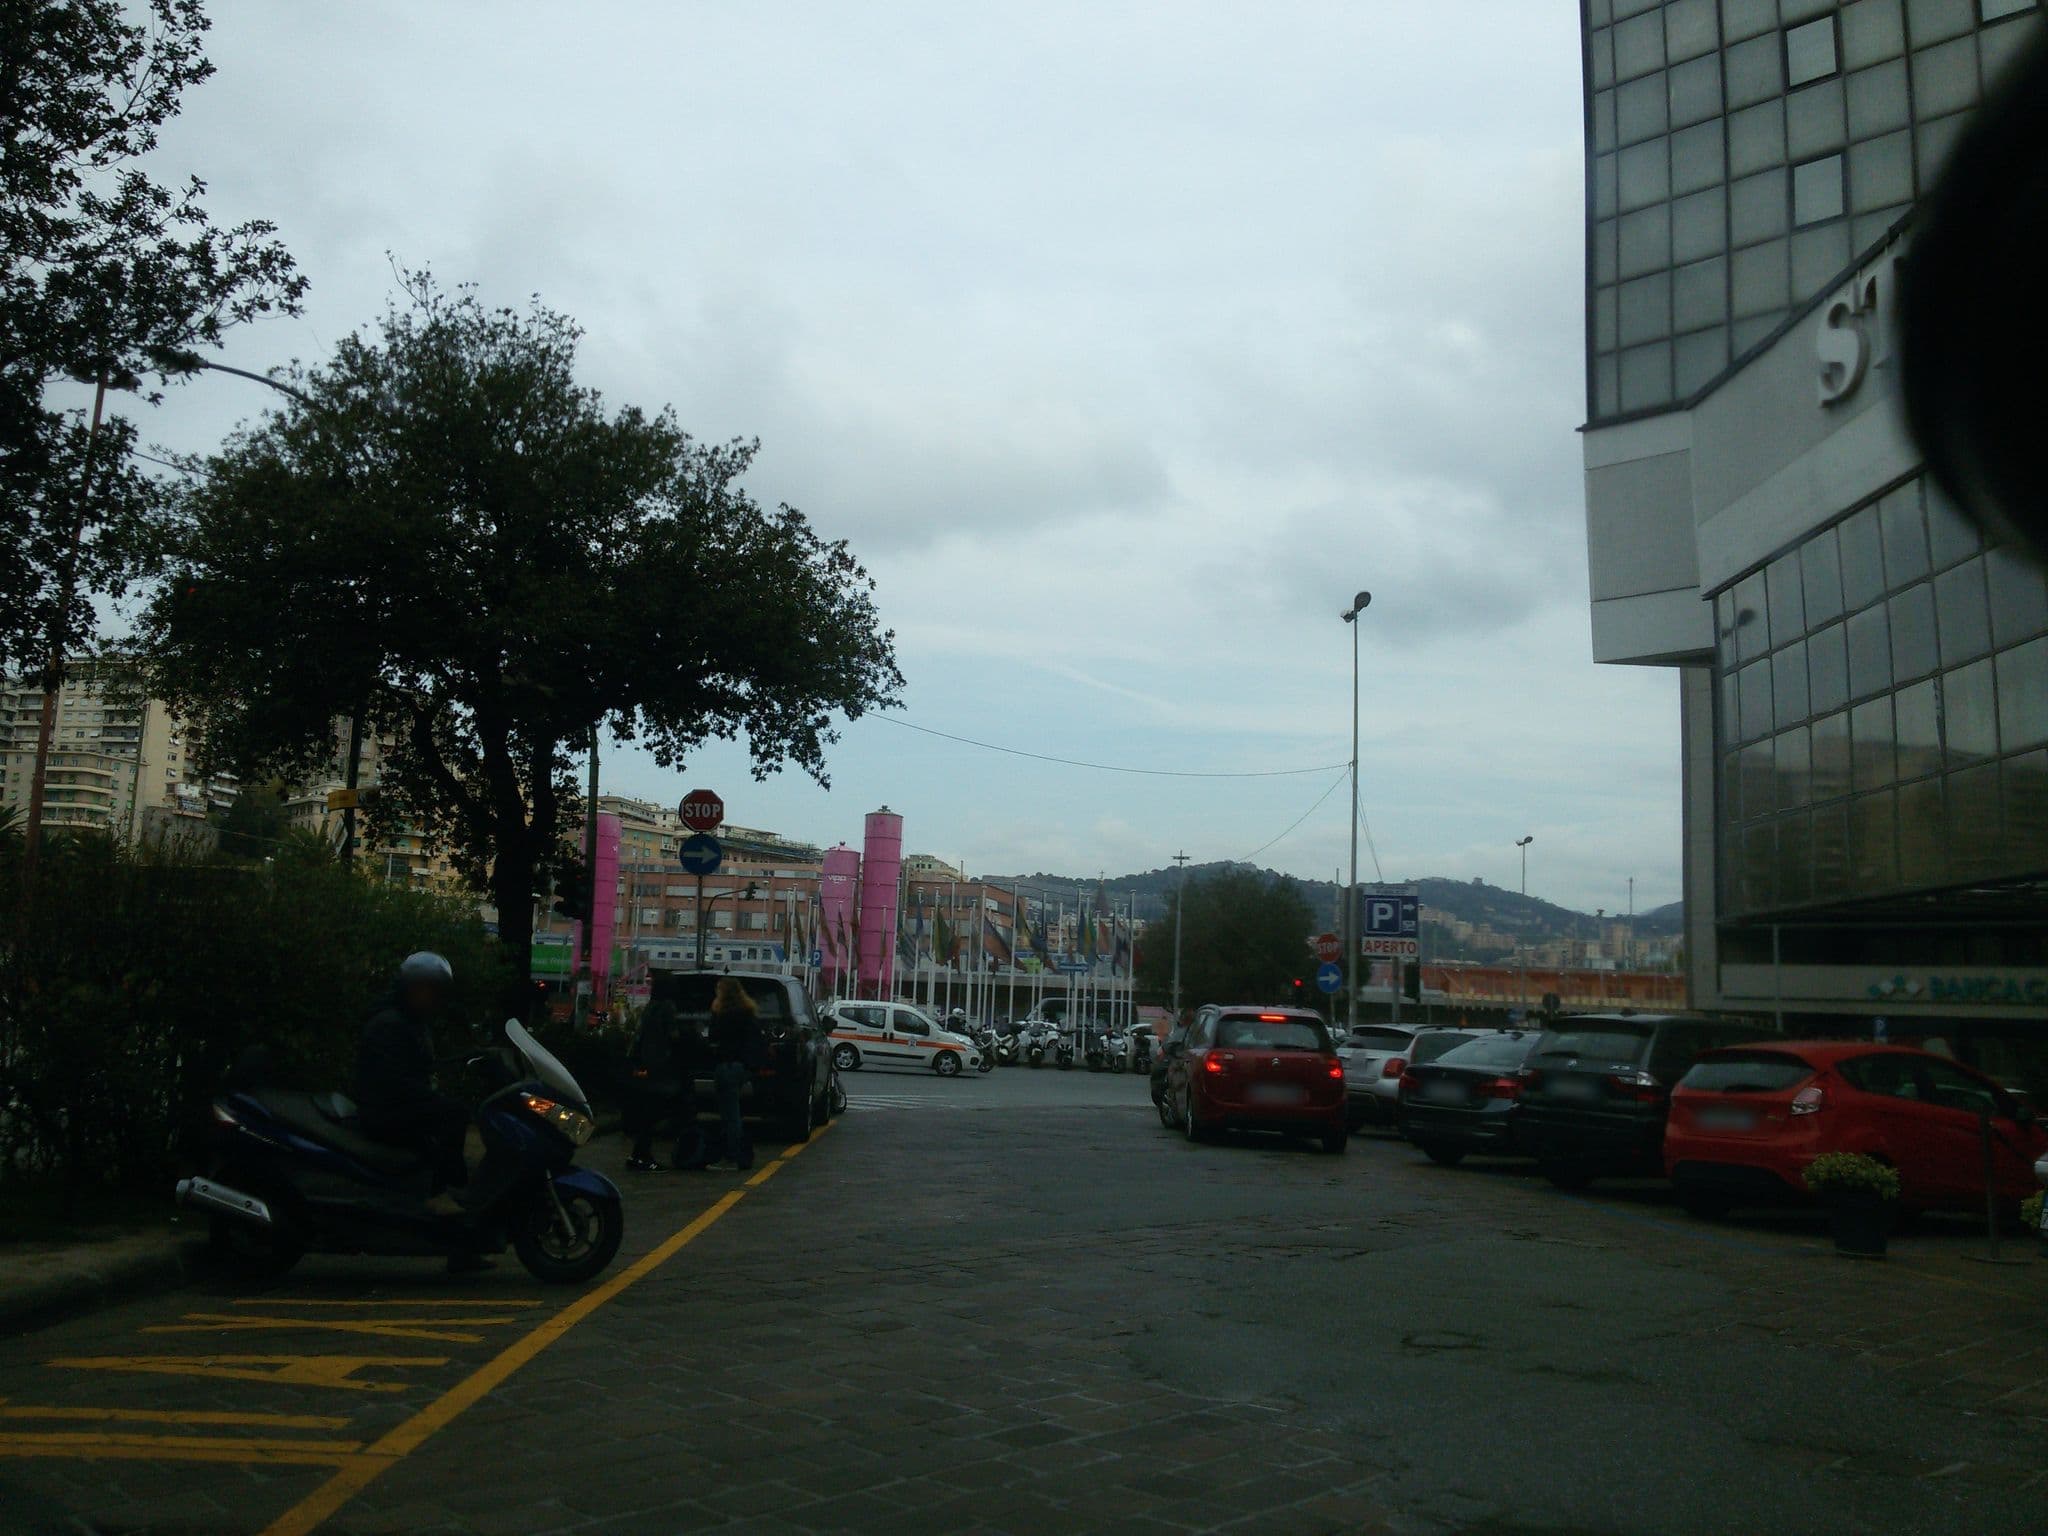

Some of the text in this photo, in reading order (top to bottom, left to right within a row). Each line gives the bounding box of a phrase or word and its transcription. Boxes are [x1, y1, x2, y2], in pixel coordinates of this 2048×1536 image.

[685, 803, 721, 818] STOP
[1372, 902, 1394, 929] P
[1364, 940, 1417, 954] APERTO
